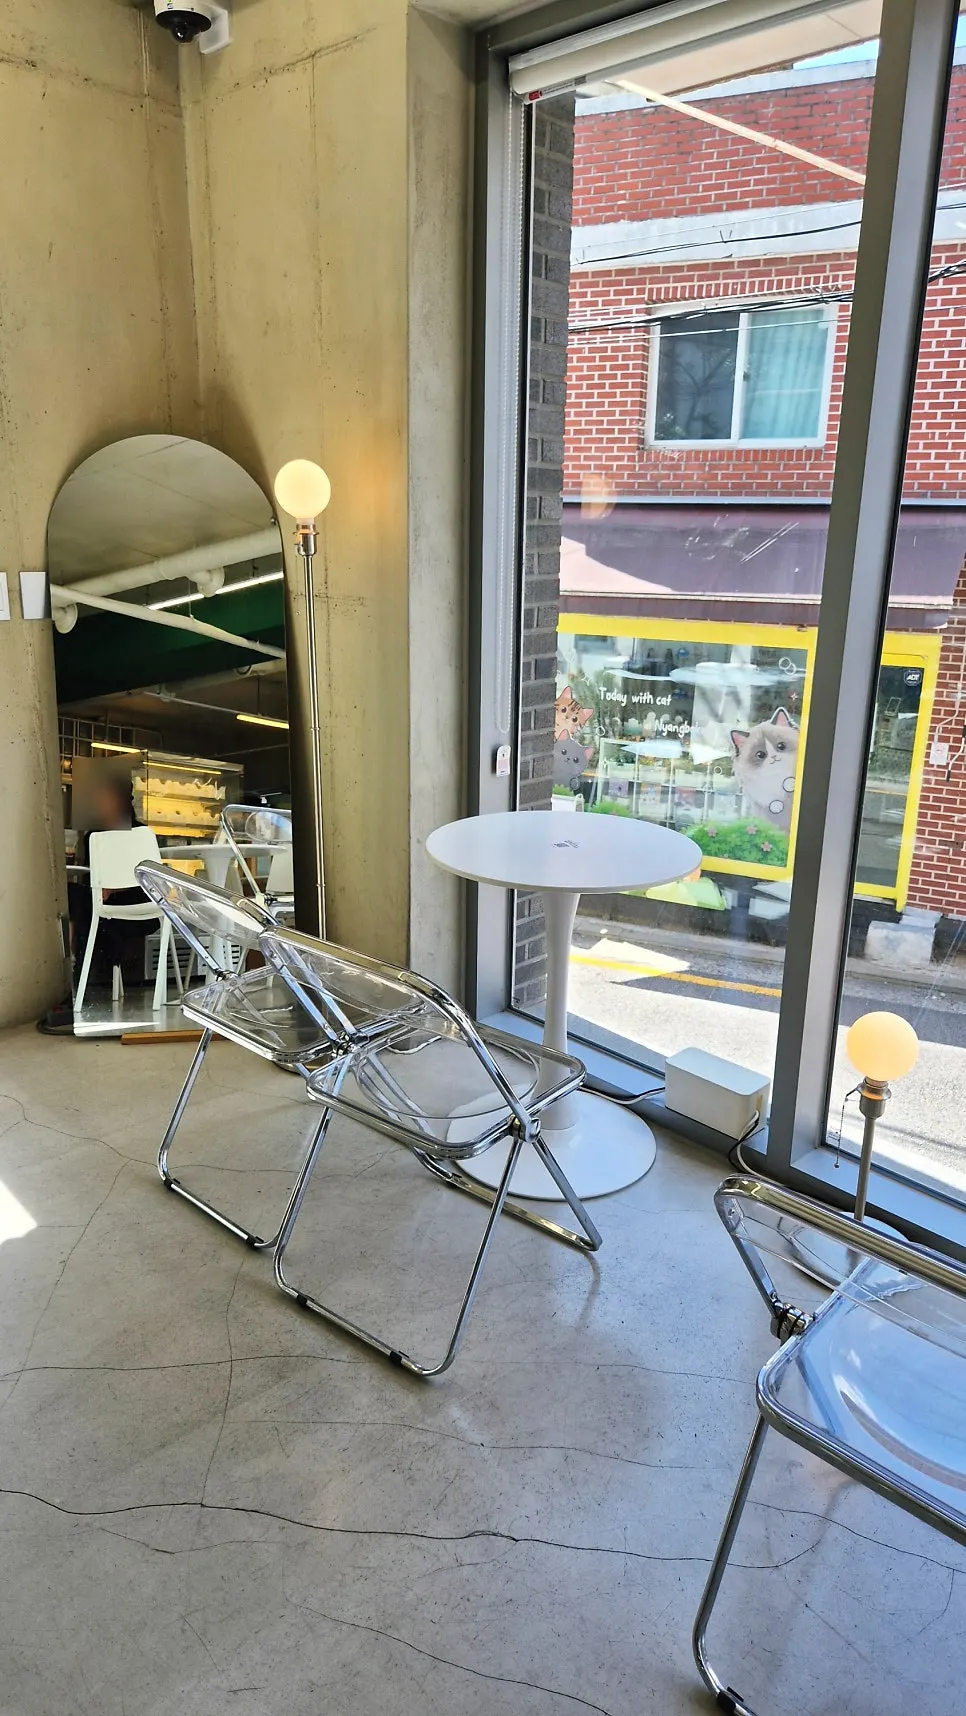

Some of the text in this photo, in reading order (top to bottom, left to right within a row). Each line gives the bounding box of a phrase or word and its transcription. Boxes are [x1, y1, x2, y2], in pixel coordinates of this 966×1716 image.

[599, 686, 672, 706] Today with cat
